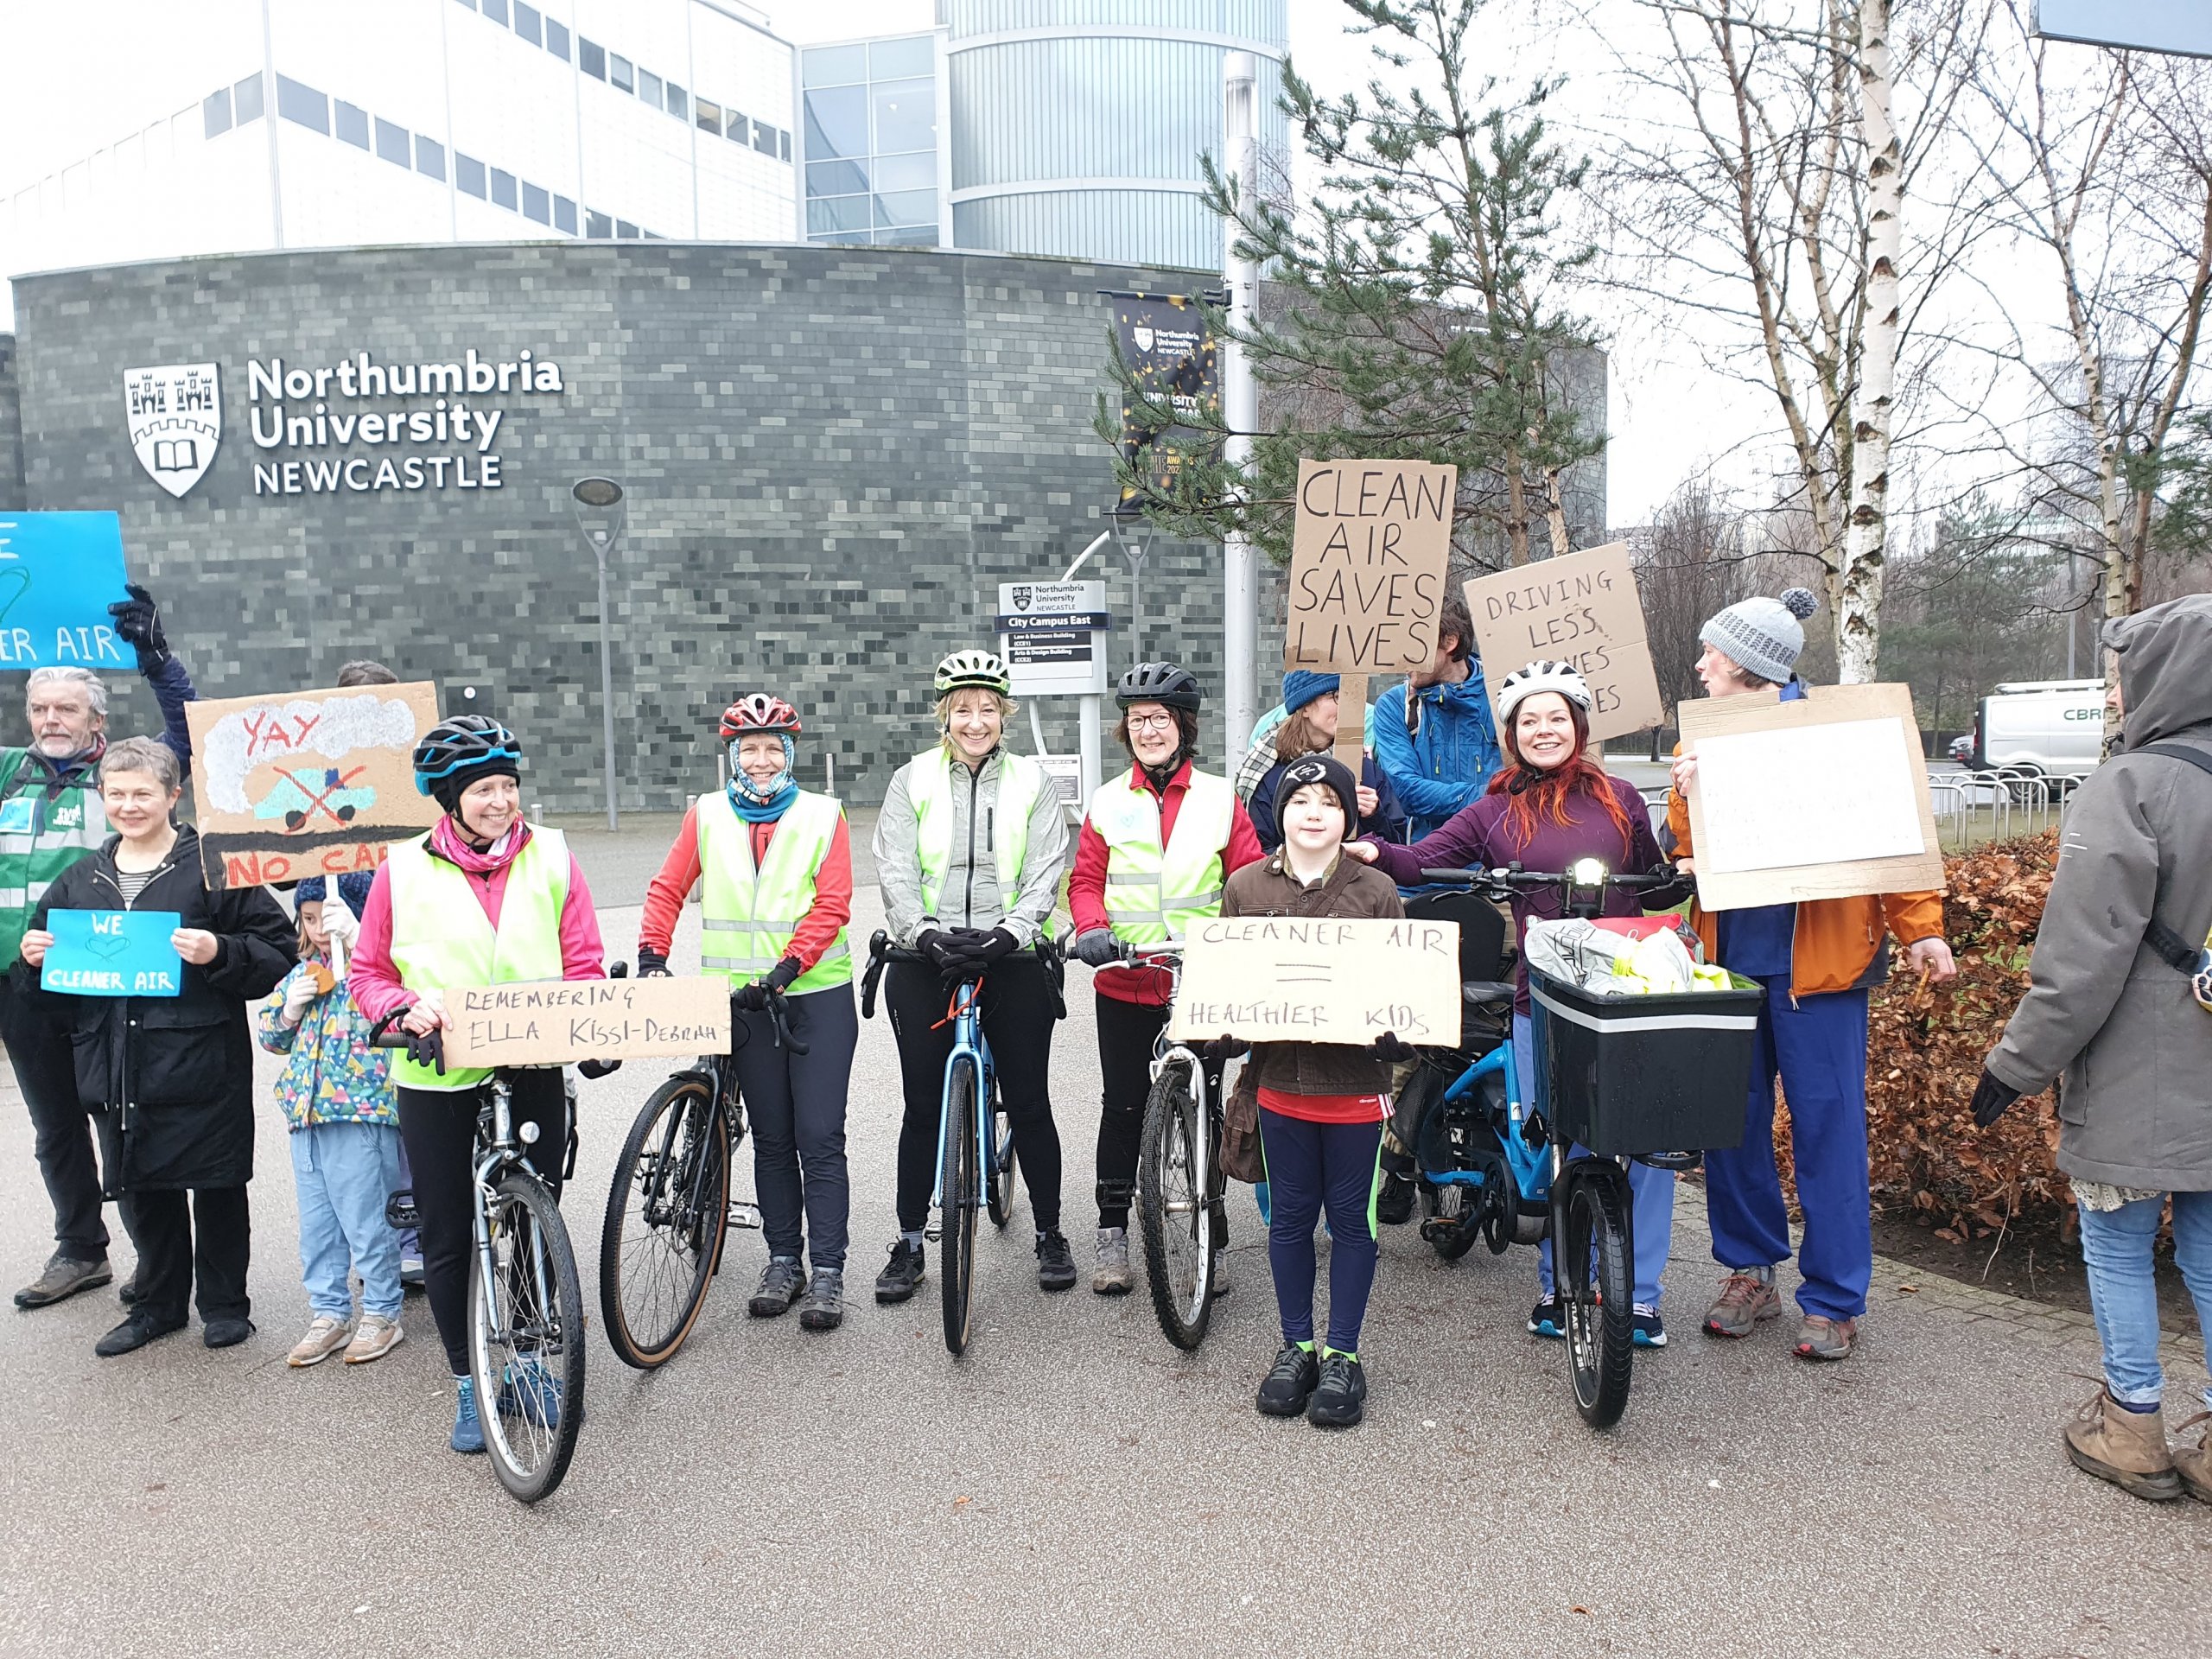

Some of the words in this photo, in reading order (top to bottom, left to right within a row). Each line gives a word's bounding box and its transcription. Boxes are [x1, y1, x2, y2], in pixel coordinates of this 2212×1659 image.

[1155, 329, 1200, 340] Northumbria
[1156, 337, 1192, 349] University
[247, 349, 563, 400] Northumbria
[251, 398, 503, 450] University
[253, 454, 502, 494] NEWCASTLE
[1166, 455, 1194, 465] AWAS
[1302, 469, 1447, 522] CLEAN
[1319, 522, 1408, 566] AIR
[1035, 584, 1084, 594] Northumbria
[1035, 594, 1075, 603] University
[1294, 568, 1437, 619] SAVES
[1485, 569, 1613, 621] DRIVING
[1008, 617, 1028, 628] City
[1029, 616, 1069, 627] Campus
[1070, 615, 1091, 626] East
[1528, 607, 1597, 649] LESS
[56, 625, 121, 662] AIR
[1295, 621, 1431, 667] LIVES
[1590, 684, 1621, 714] ES
[2063, 708, 2107, 721] CBR
[243, 710, 321, 757] YAY
[227, 850, 292, 887] NO
[92, 912, 124, 935] WE
[1202, 922, 1357, 945] CLEANER
[1386, 923, 1448, 956] AIR
[47, 969, 125, 990] CLEANER
[134, 971, 175, 990] AIR
[465, 985, 636, 1012] REMEMBERING
[467, 1020, 540, 1051] ELLA
[1188, 1000, 1329, 1027] HEALTHIER
[1365, 1003, 1430, 1036] KIDS
